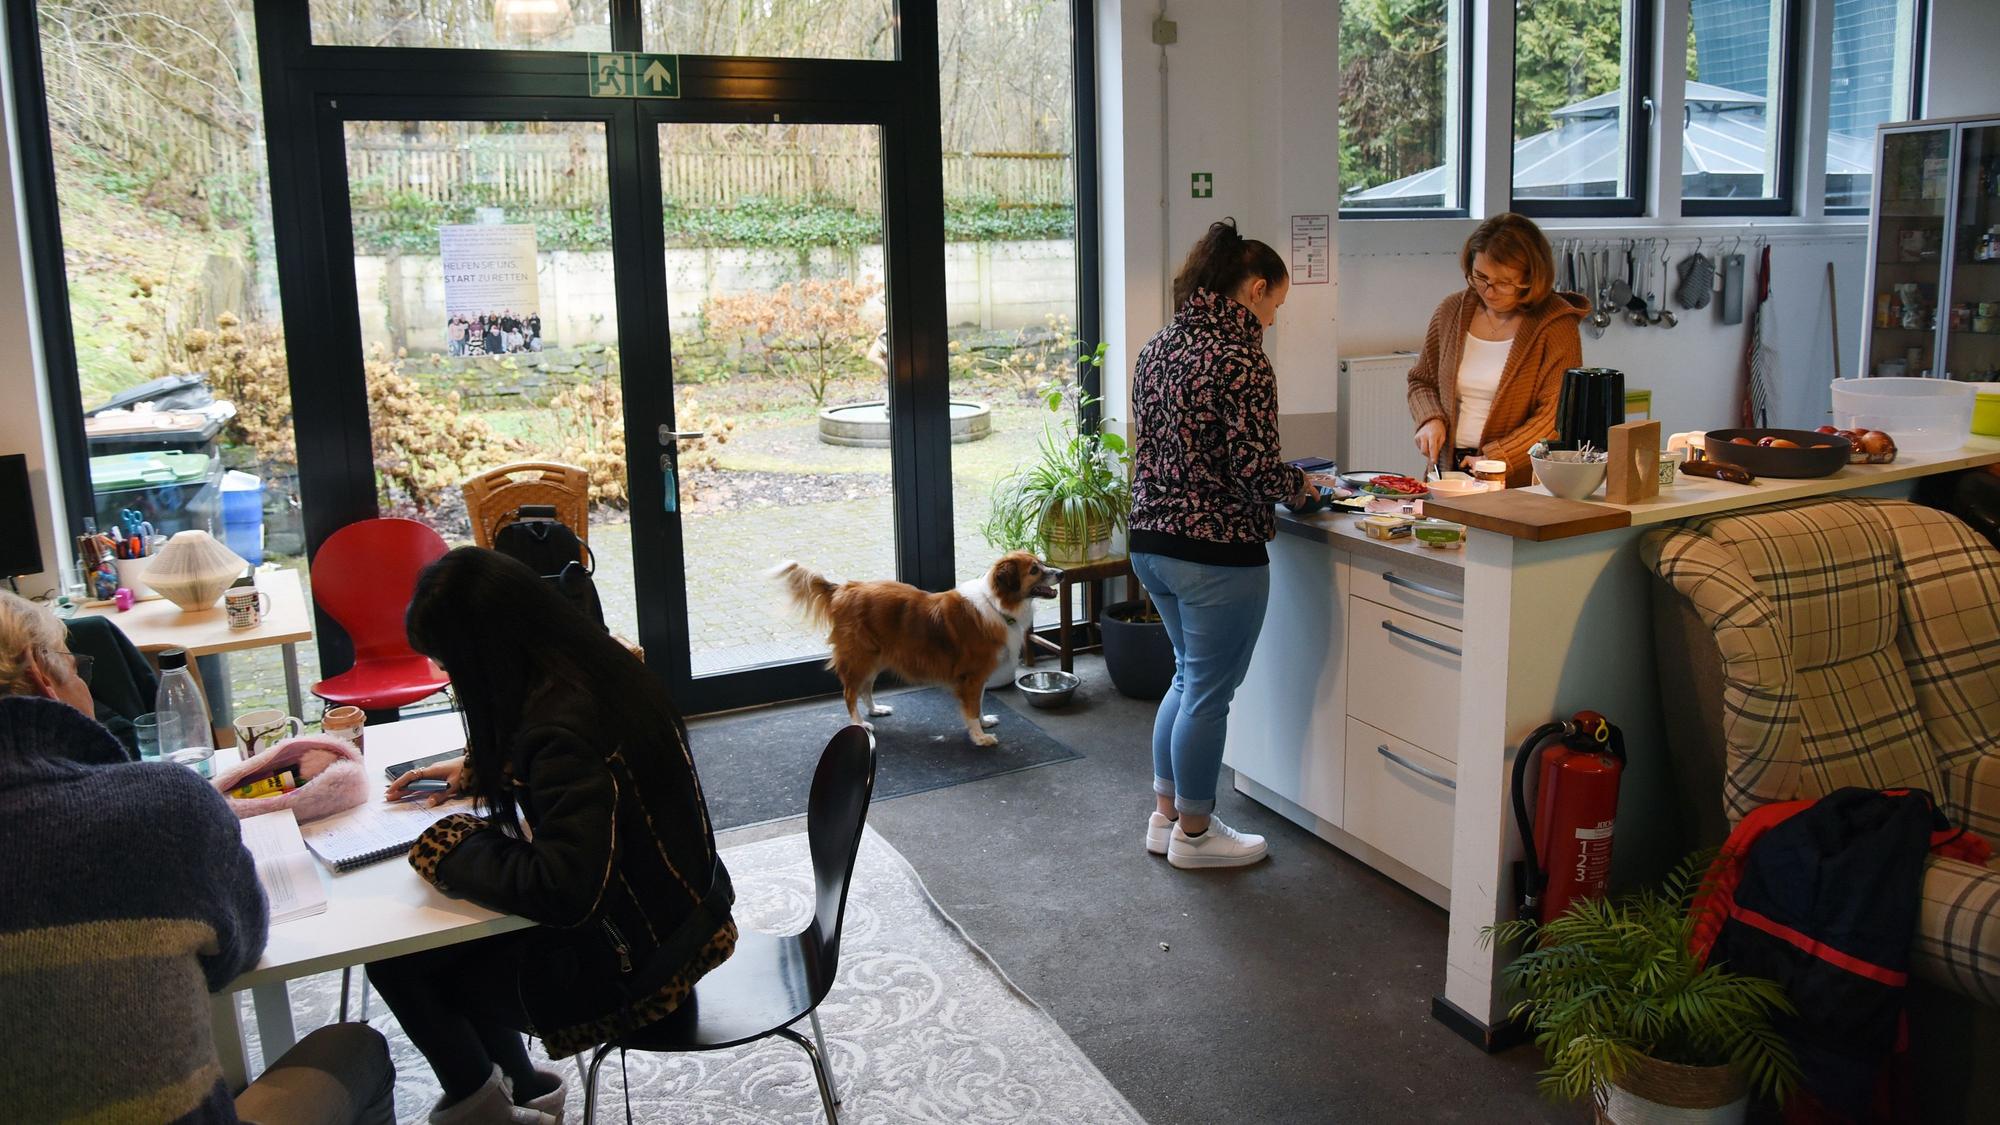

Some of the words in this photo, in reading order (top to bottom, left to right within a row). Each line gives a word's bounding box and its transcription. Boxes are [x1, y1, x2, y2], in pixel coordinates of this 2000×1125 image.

[444, 261, 480, 270] HELFEN
[481, 261, 496, 270] SIE
[445, 274, 475, 283] START
[478, 274, 491, 282] ZU
[492, 273, 528, 281] RETTEN
[1580, 841, 1587, 854] 1
[1576, 855, 1587, 868] 2
[1575, 869, 1585, 881] 3
